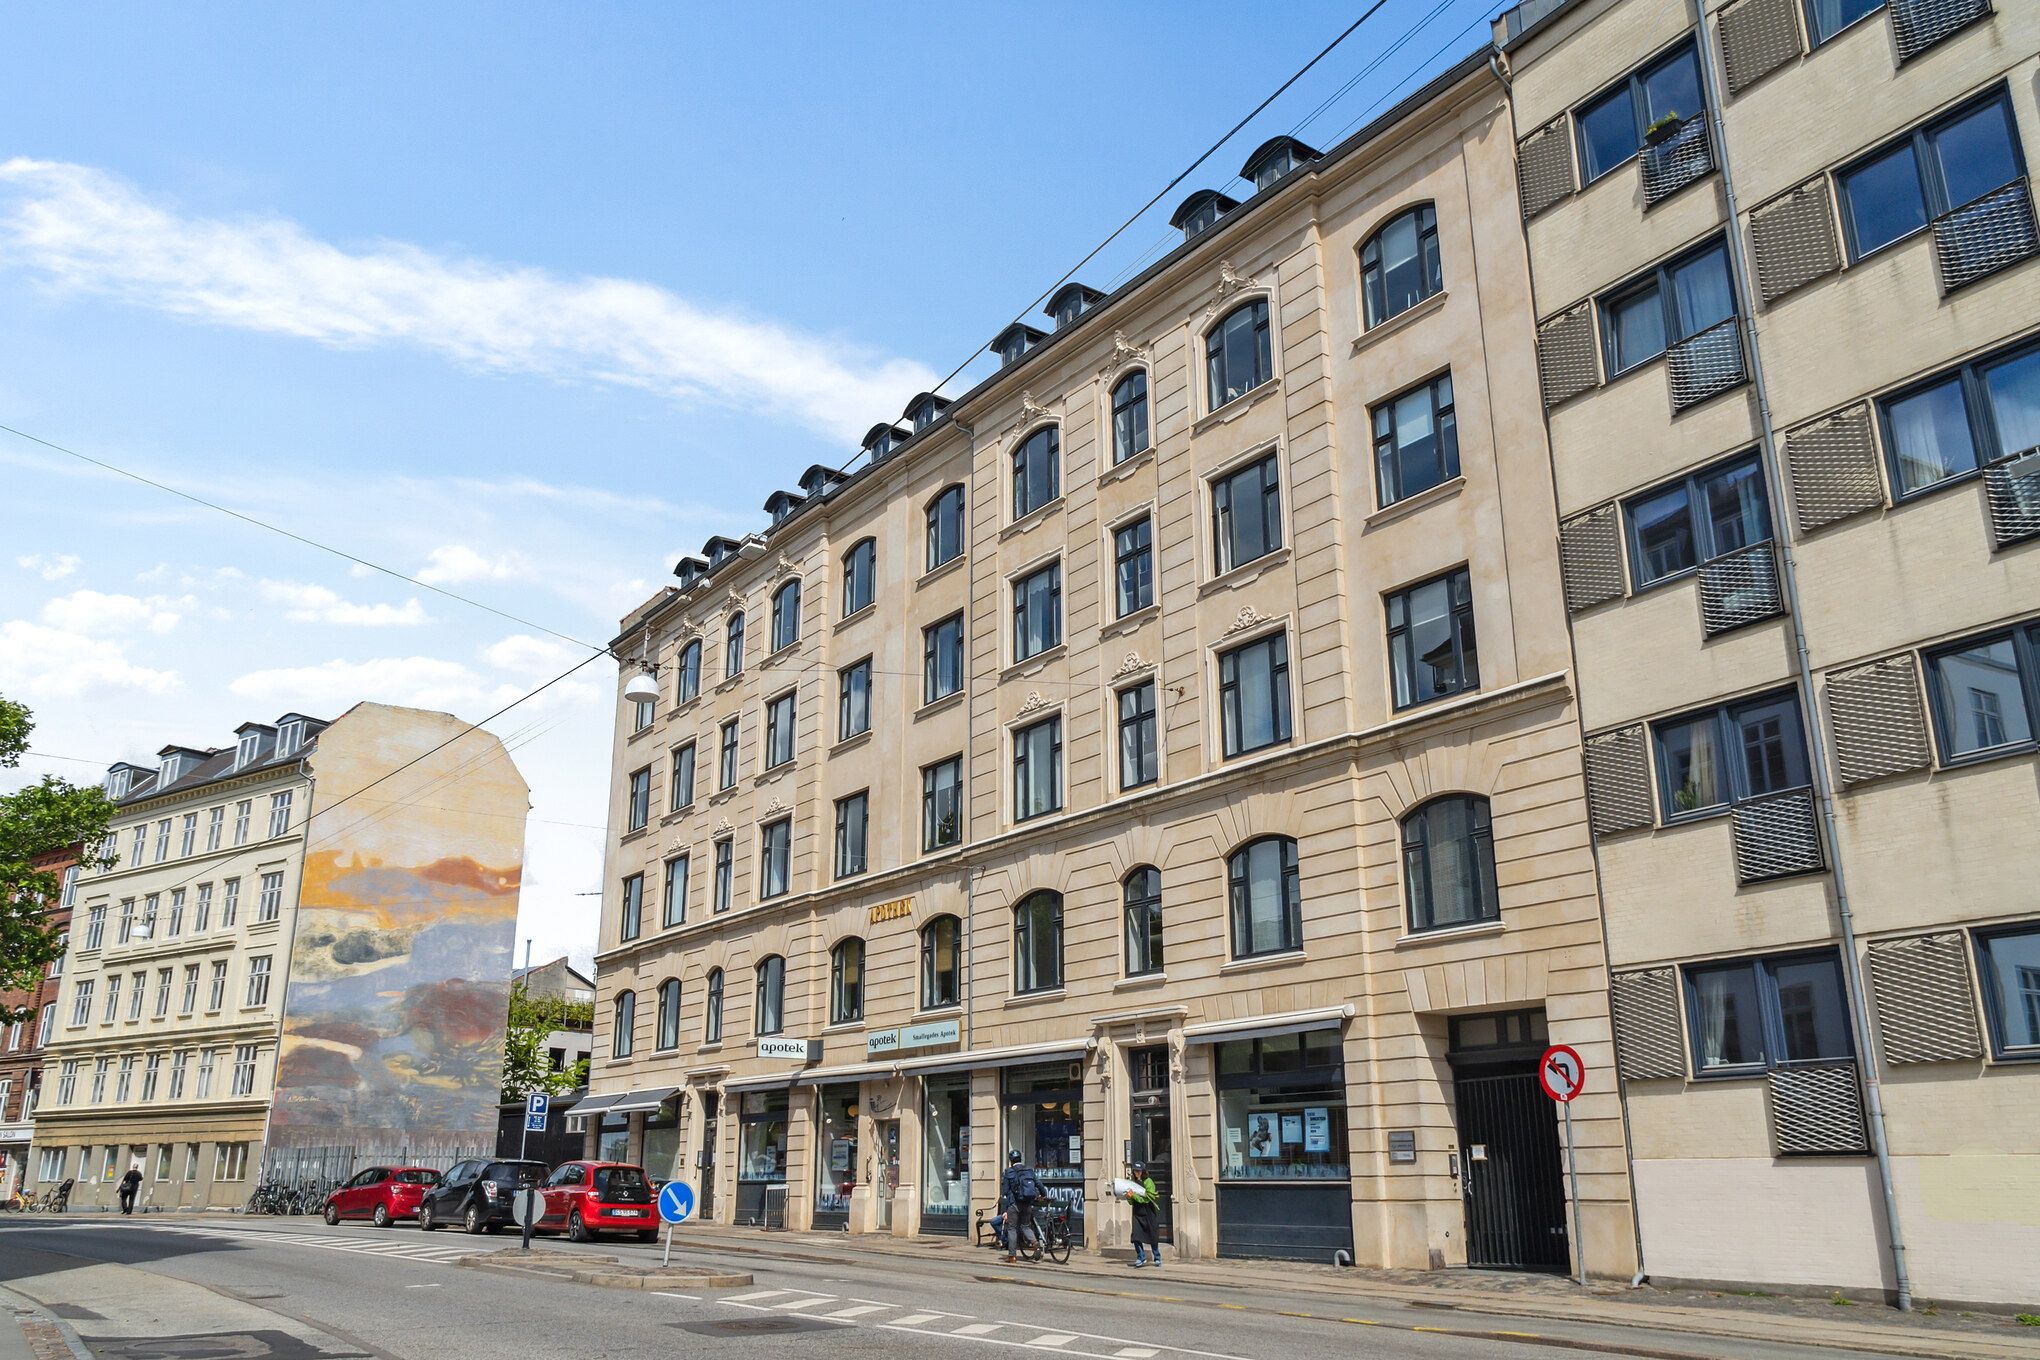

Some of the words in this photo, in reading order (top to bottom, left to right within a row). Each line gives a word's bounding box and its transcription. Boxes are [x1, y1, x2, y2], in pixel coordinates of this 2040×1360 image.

[869, 1033, 896, 1049] apotek
[912, 1032, 939, 1041] Smallegades
[940, 1029, 956, 1038] Apotek
[761, 1043, 804, 1054] apotek
[532, 1096, 544, 1112] P
